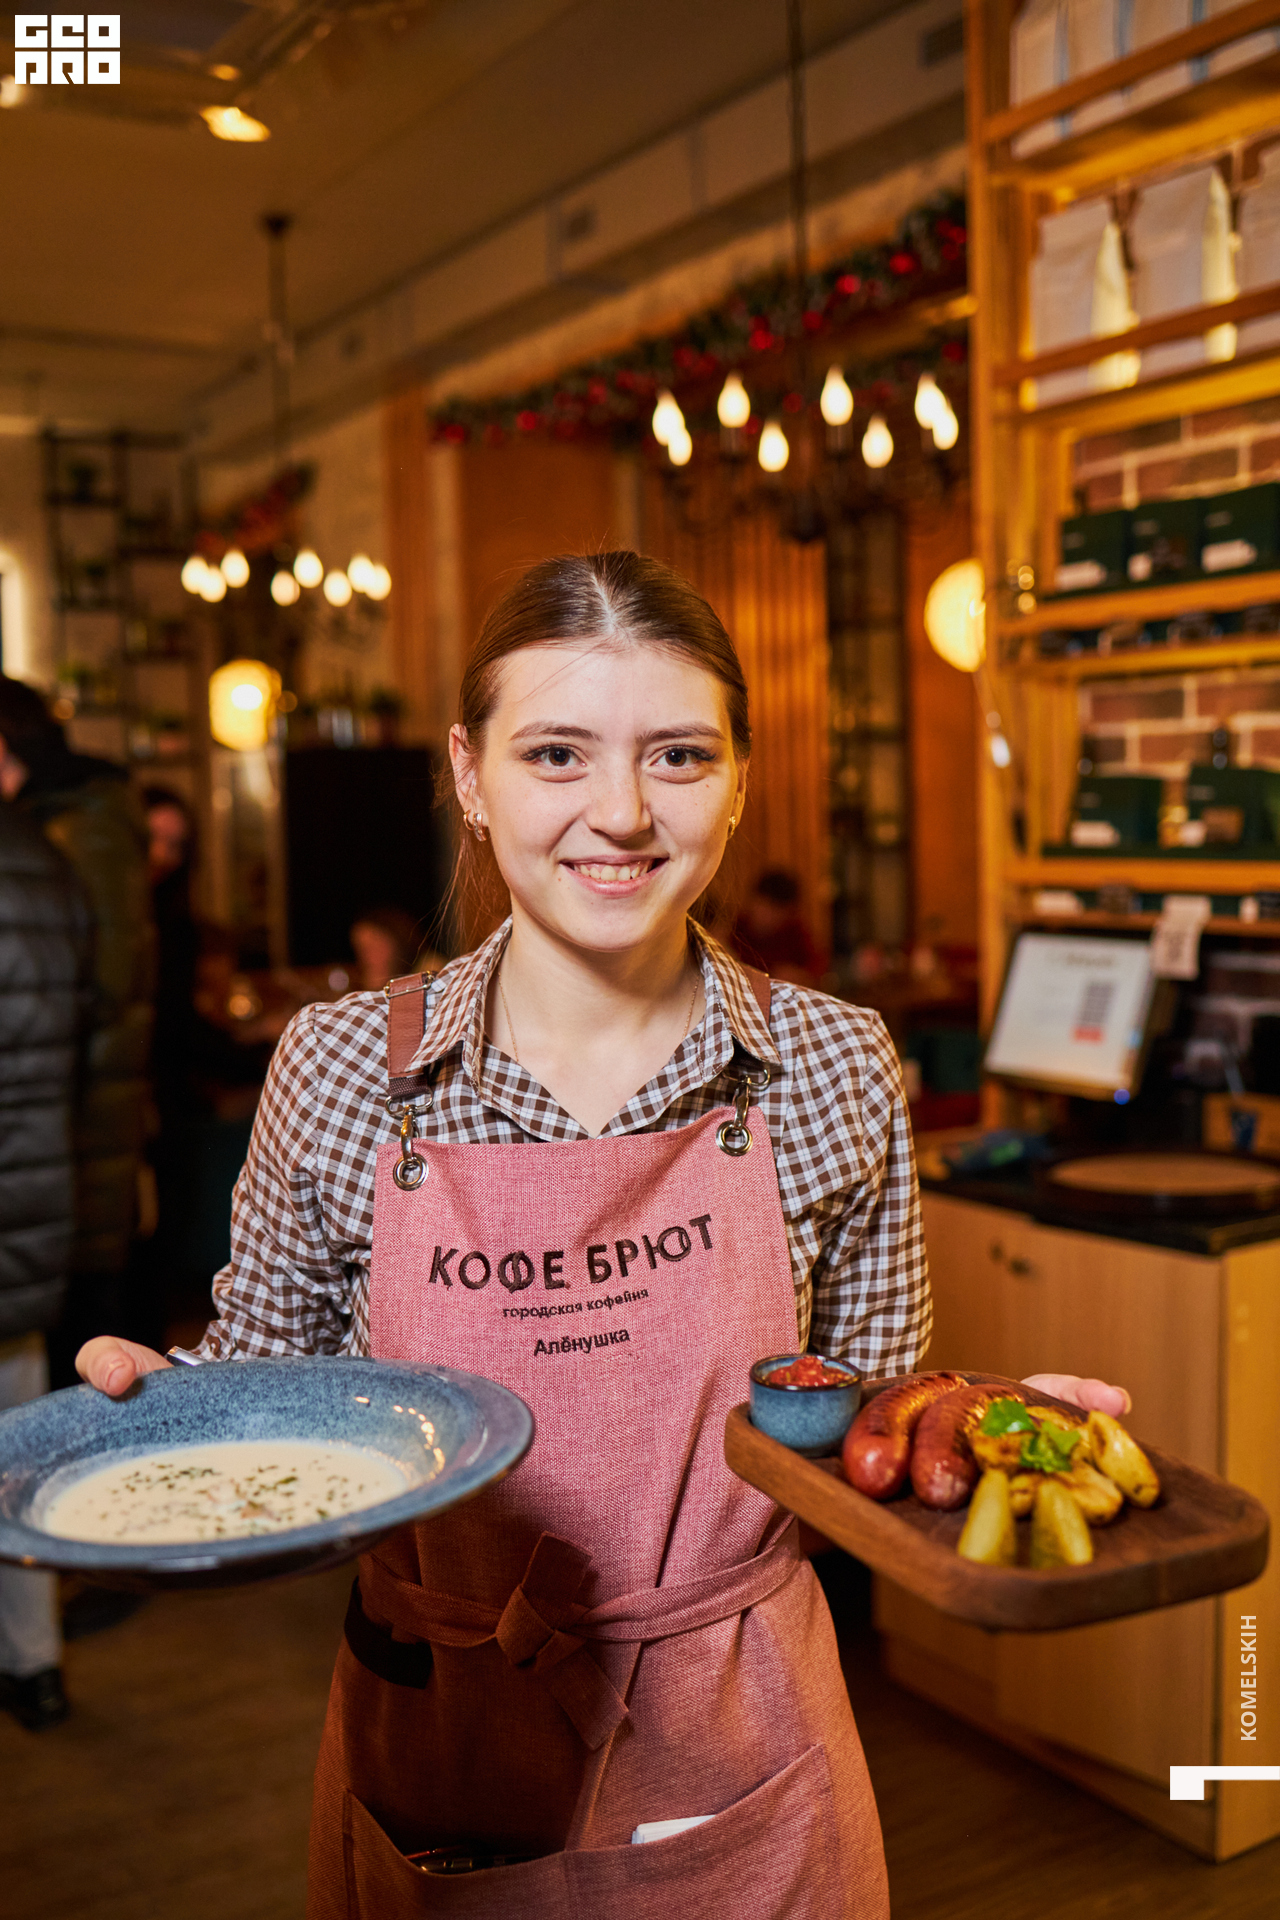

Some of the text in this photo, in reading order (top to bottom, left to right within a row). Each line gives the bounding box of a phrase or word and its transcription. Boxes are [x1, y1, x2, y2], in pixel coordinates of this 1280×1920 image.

[428, 1213, 713, 1293] КОФЕ БРЮТ
[502, 1288, 650, 1320] городская кофейня
[533, 1329, 630, 1356] Алёнушка
